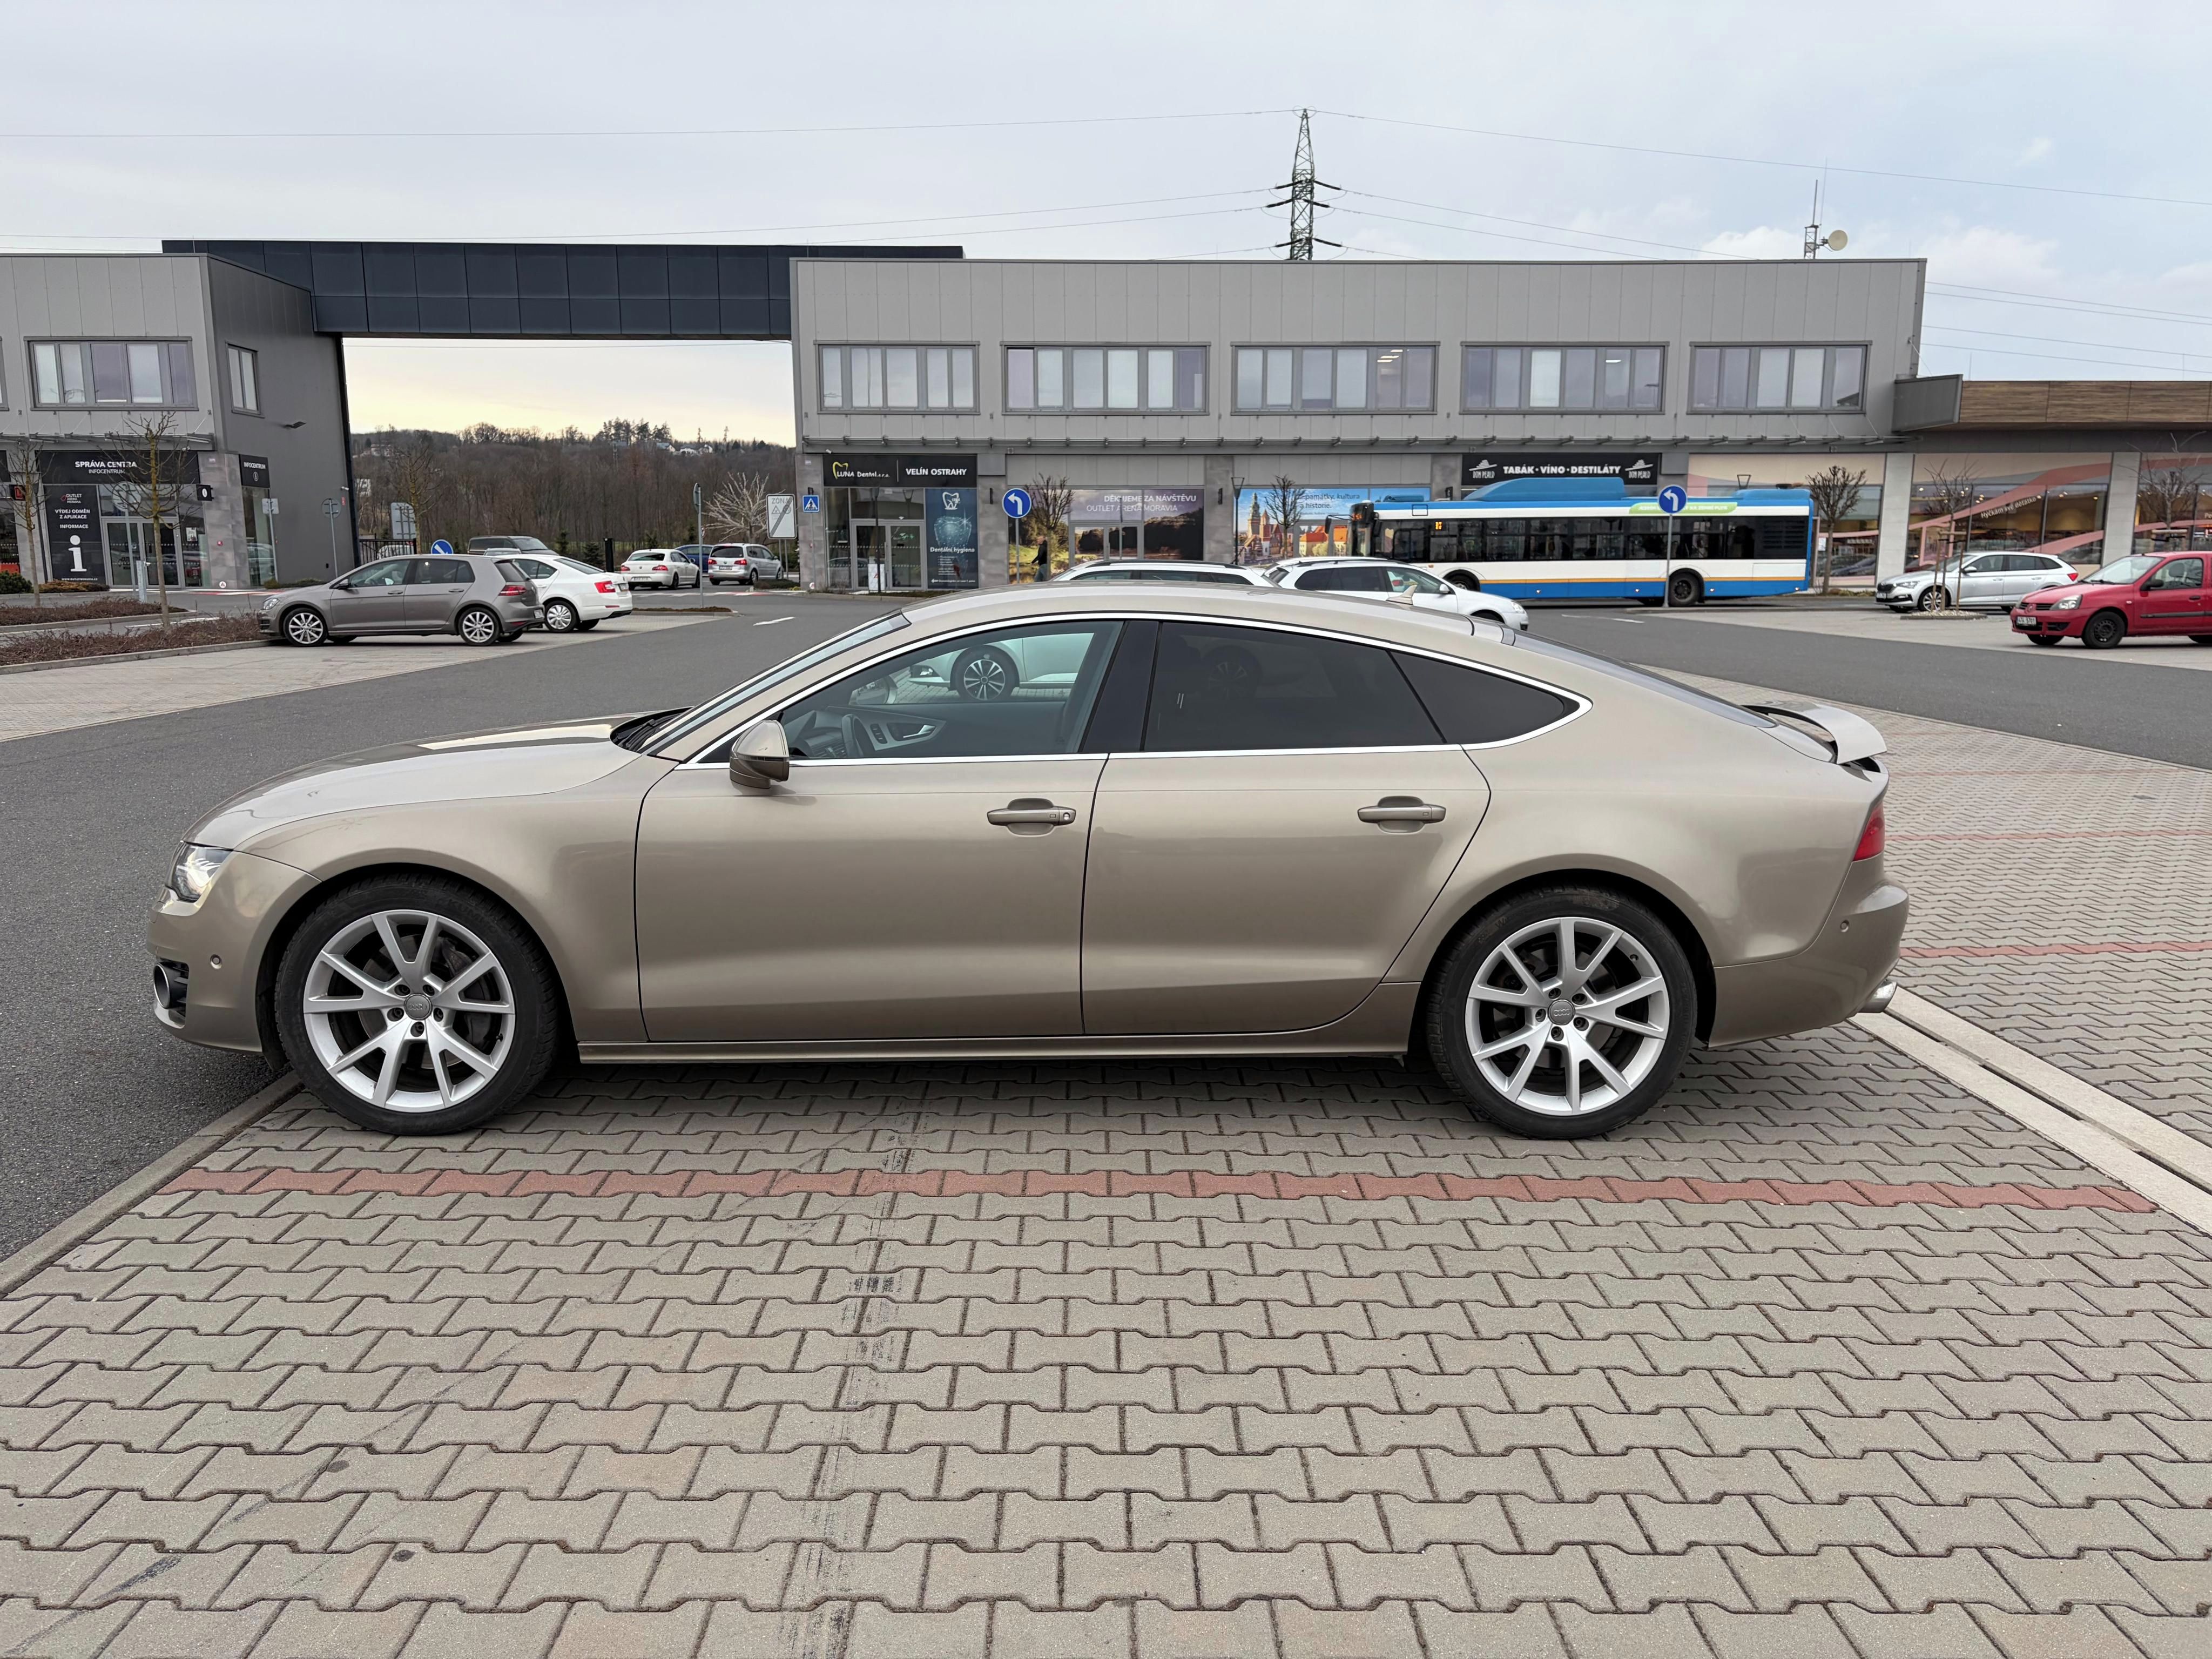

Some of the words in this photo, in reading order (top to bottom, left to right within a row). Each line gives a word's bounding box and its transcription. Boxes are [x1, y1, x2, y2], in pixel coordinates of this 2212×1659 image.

[75, 460, 106, 468] SPRÁVA
[906, 467, 928, 475] VELÍN
[1503, 464, 1535, 474] TABÁK
[1540, 464, 1566, 474] VÍNO
[1570, 464, 1621, 474] DESTILÁTY
[1156, 494, 1197, 502] NÁVŠTĚVU
